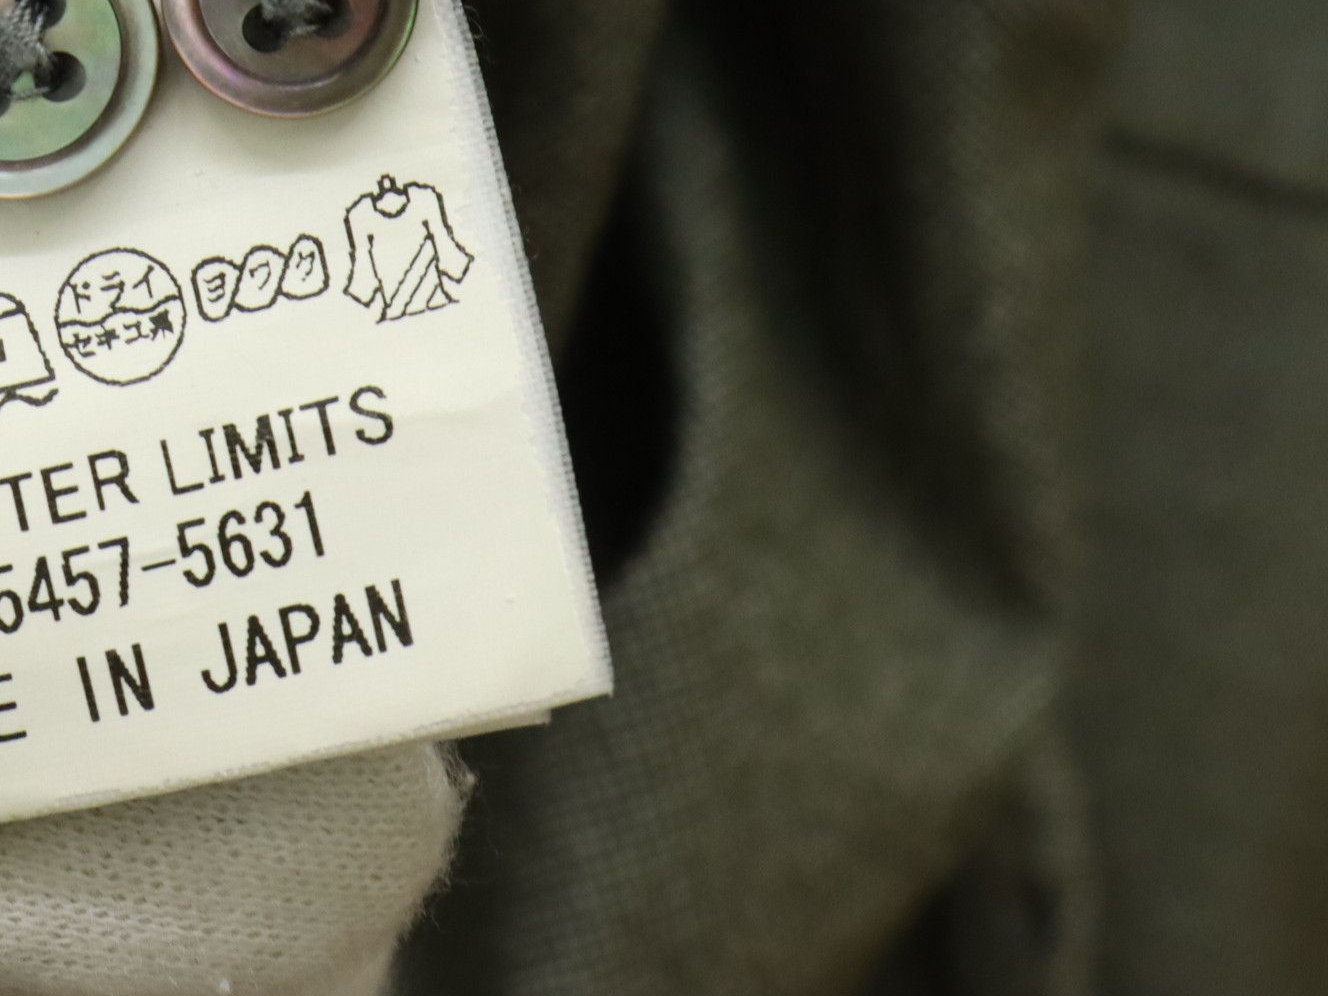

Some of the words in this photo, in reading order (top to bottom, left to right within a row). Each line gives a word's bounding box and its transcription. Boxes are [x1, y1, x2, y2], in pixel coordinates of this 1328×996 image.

[69, 264, 156, 314] ドライ
[159, 385, 395, 496] LIMITS
[77, 642, 156, 723] IN
[200, 578, 414, 694] JAPAN
